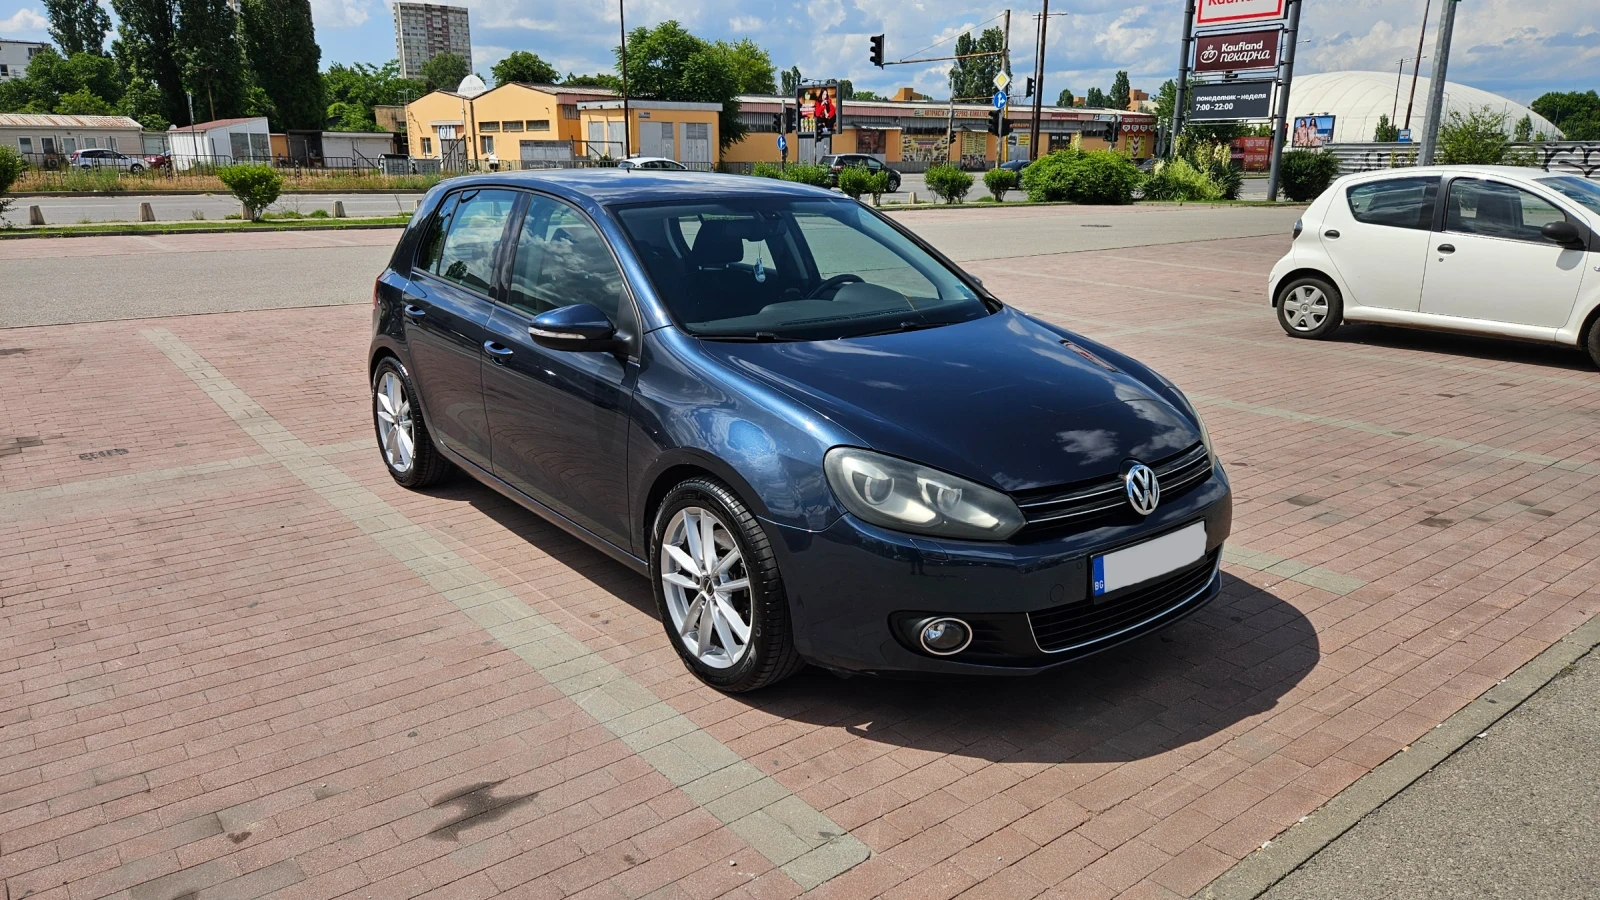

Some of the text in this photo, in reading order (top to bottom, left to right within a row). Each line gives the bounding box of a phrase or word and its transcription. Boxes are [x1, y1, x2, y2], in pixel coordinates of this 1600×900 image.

[1221, 40, 1263, 52] Kaufland
[1220, 50, 1270, 63] пекарна
[1241, 93, 1266, 101] неделя
[1095, 580, 1104, 590] BG
